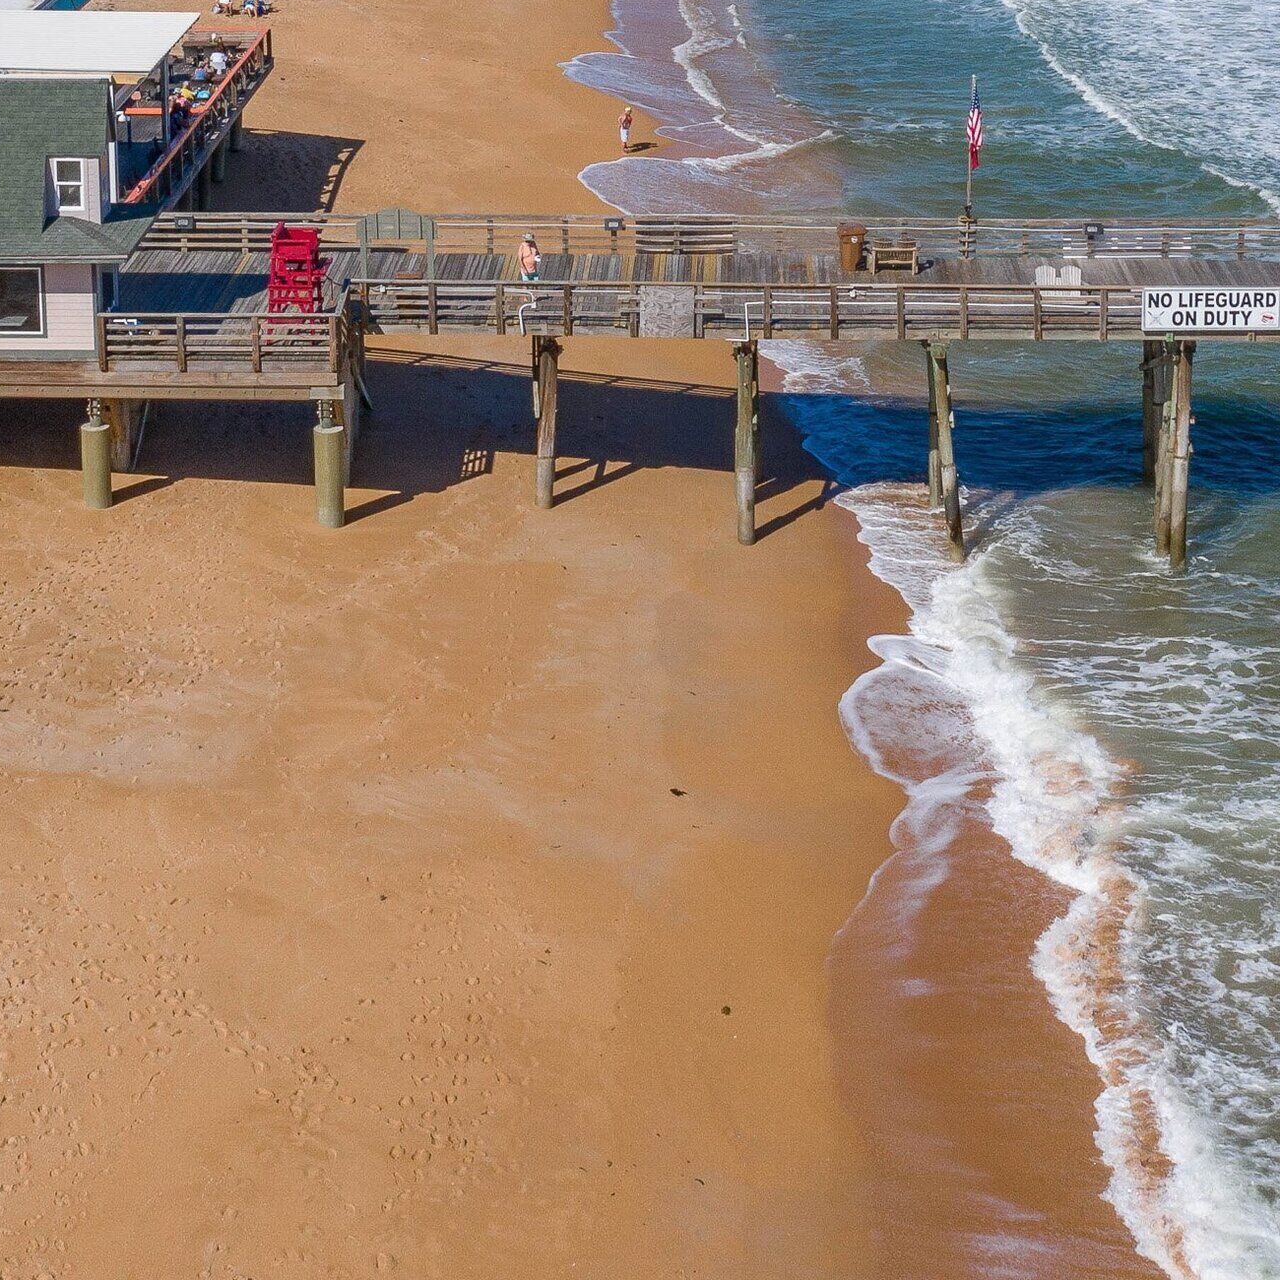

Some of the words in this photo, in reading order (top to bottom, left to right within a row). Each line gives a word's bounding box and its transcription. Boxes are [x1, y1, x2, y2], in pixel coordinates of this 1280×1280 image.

[1148, 292, 1172, 308] NO
[1178, 292, 1277, 308] LIFEGUARD
[1172, 311, 1197, 326] ON
[1204, 311, 1253, 326] DUTY
